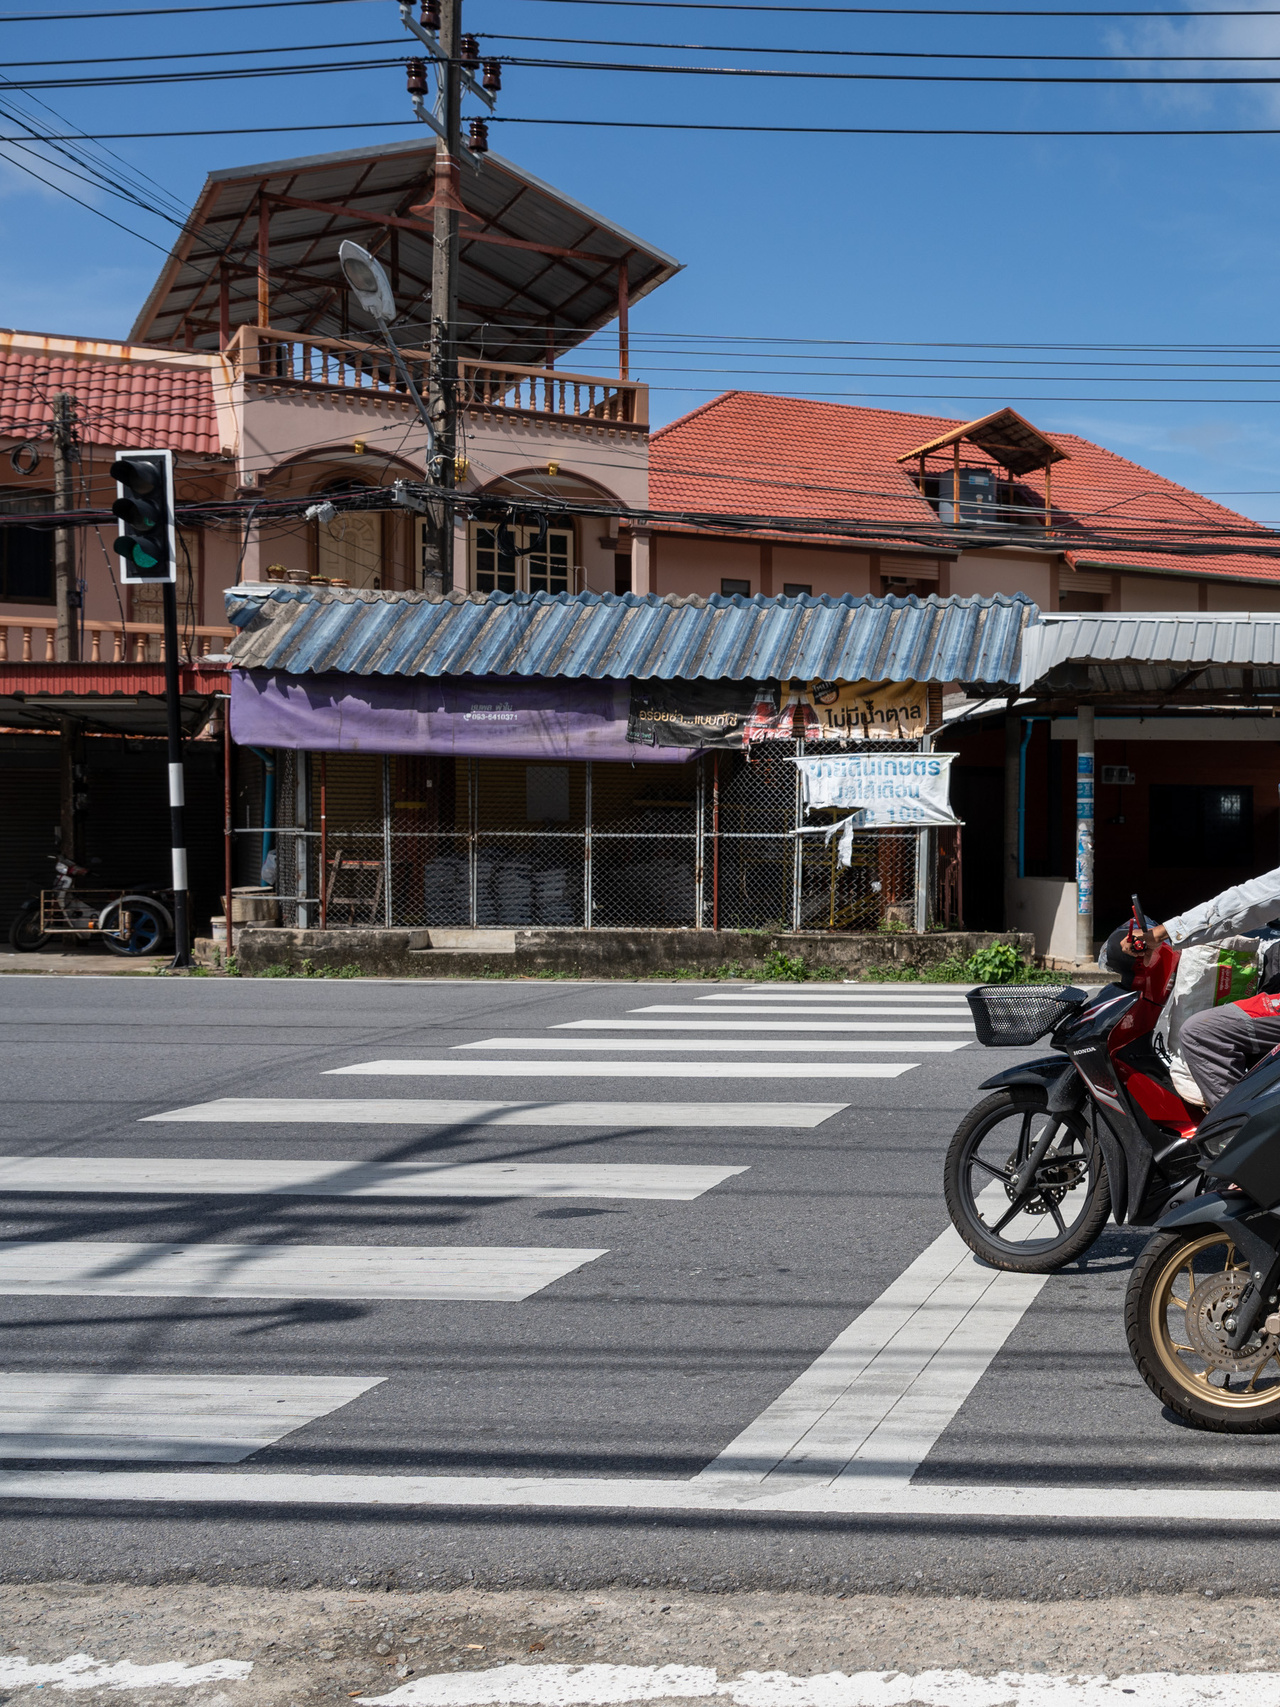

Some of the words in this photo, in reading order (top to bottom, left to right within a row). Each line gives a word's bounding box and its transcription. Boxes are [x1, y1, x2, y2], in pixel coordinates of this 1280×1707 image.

[824, 699, 922, 728] ไม่มีน้ำตาล
[886, 805, 926, 822] 100
[1072, 1046, 1097, 1056] HONDA
